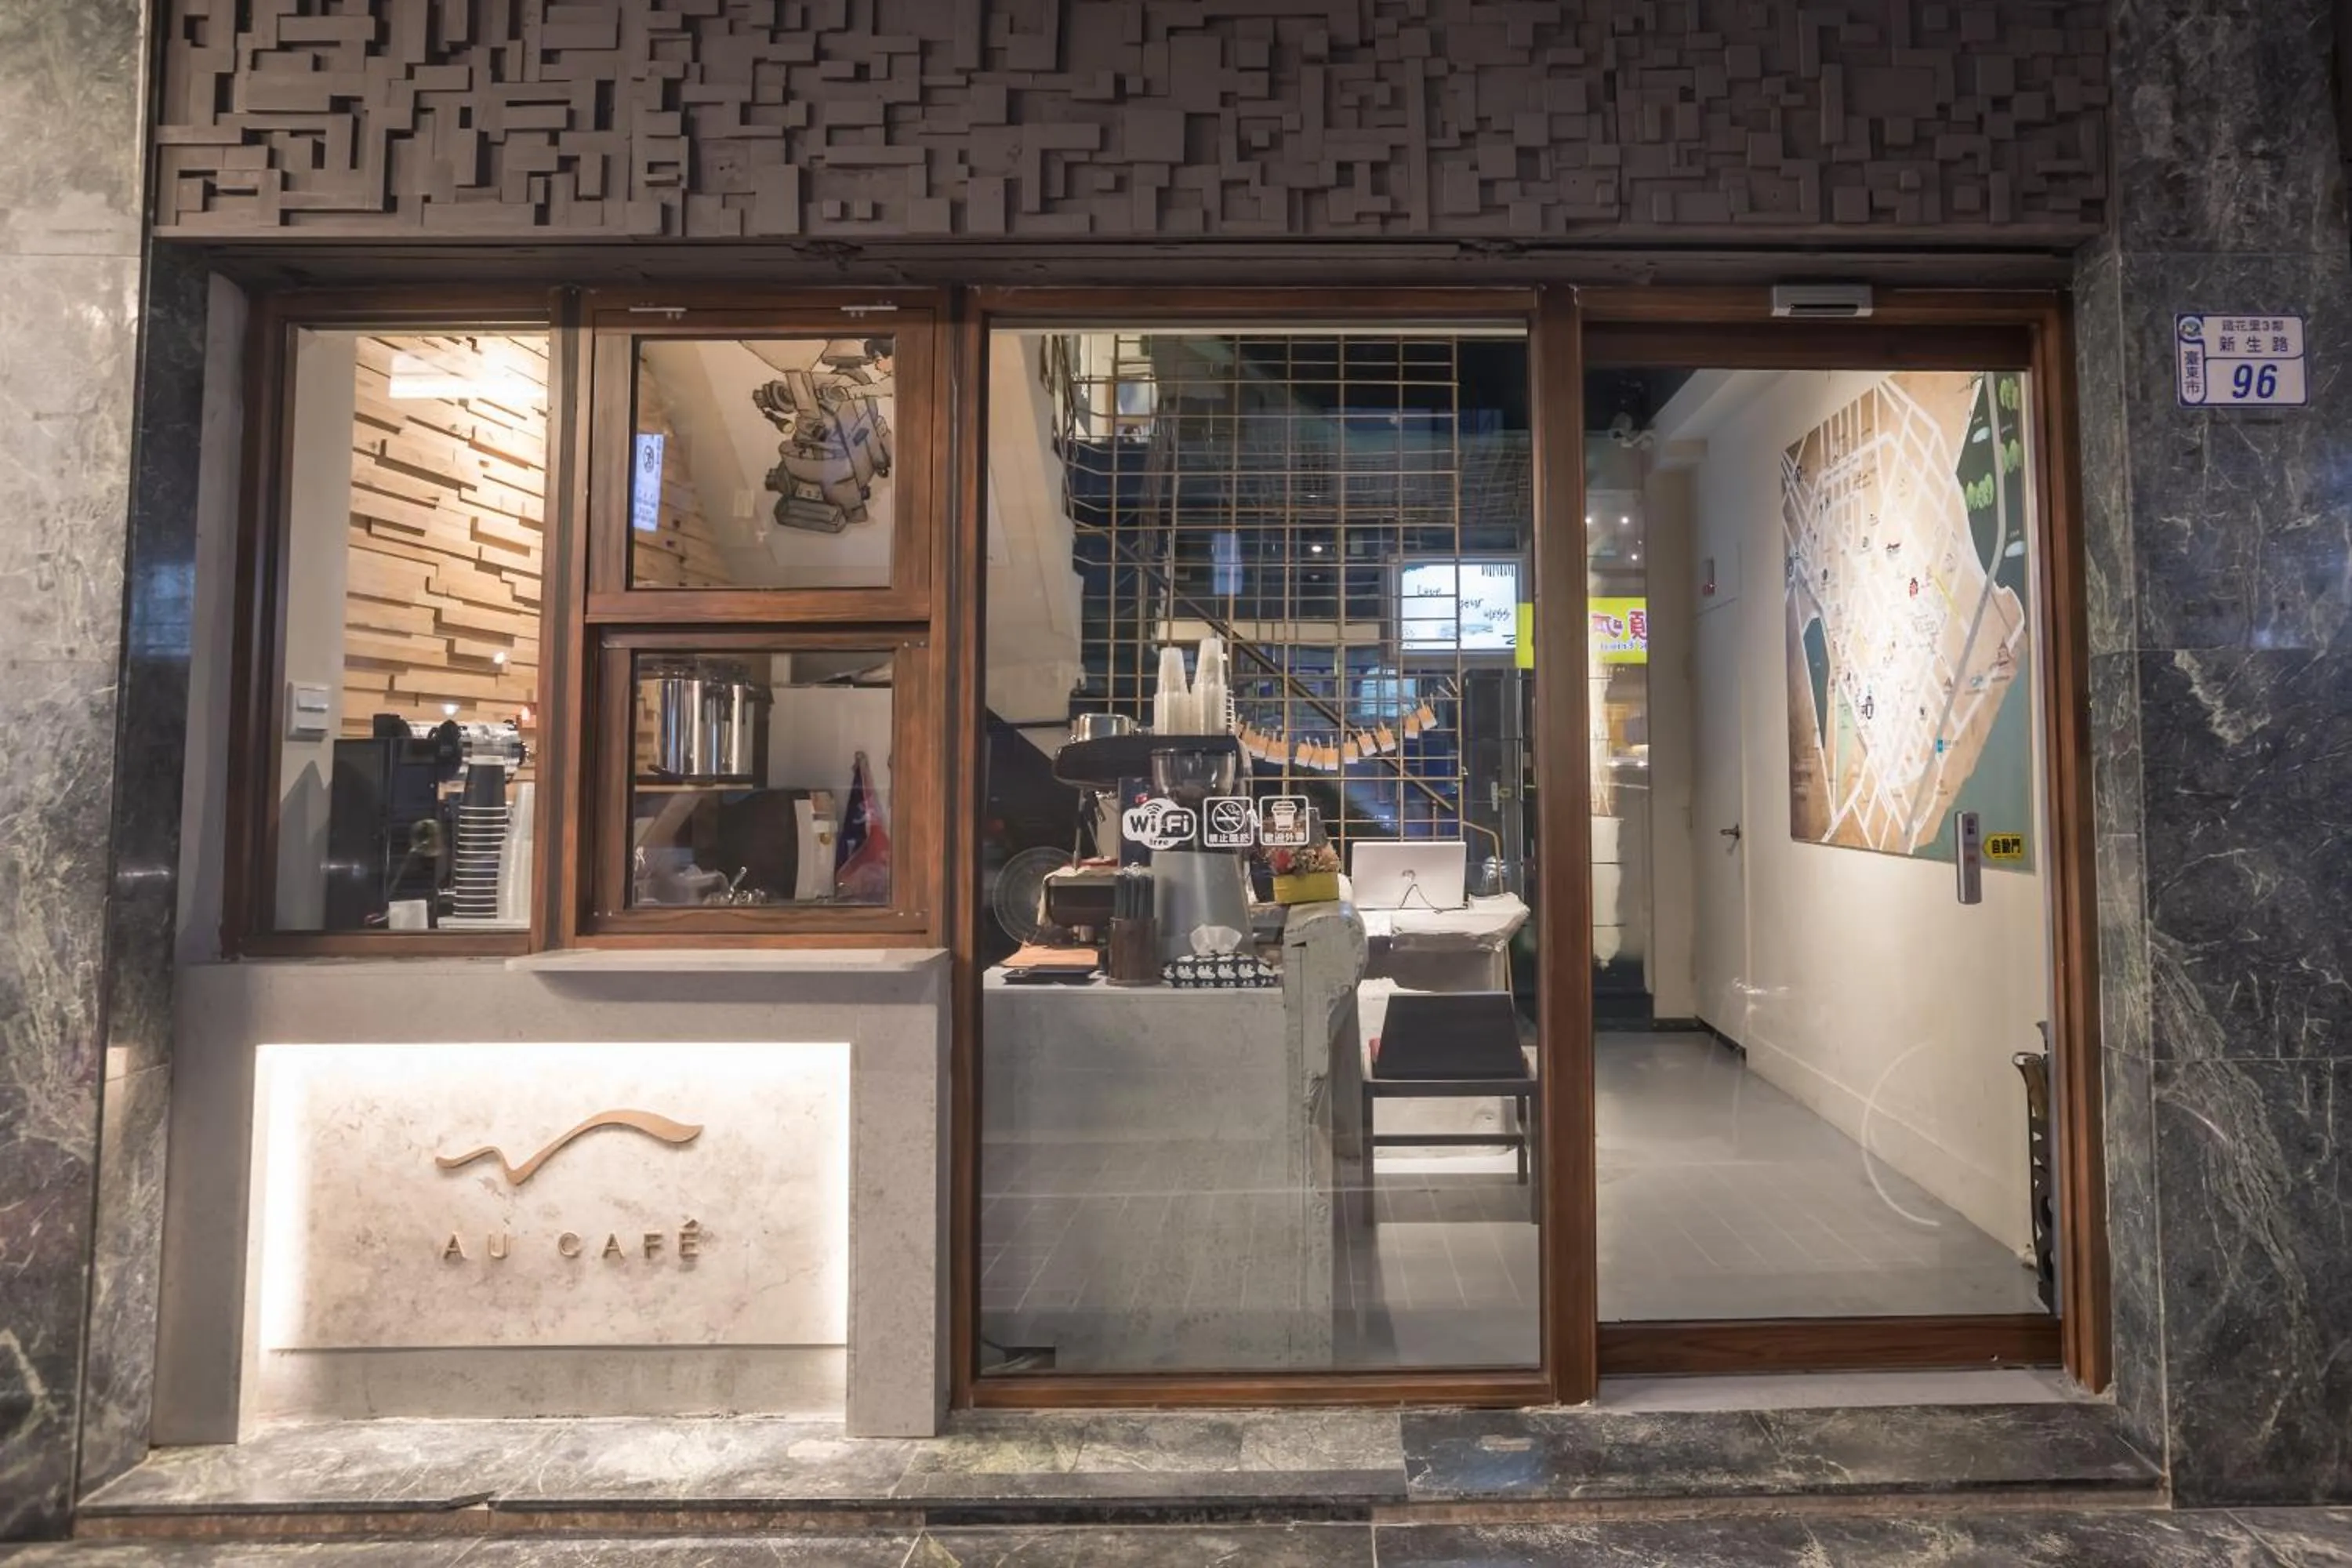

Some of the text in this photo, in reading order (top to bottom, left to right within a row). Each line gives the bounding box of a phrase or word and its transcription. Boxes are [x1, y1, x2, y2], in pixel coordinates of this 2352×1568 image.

[2220, 336, 2289, 354] 新生路
[2232, 363, 2278, 400] 96
[1991, 838, 2021, 854] 自動門
[443, 1218, 701, 1261] AU CAFÉ
